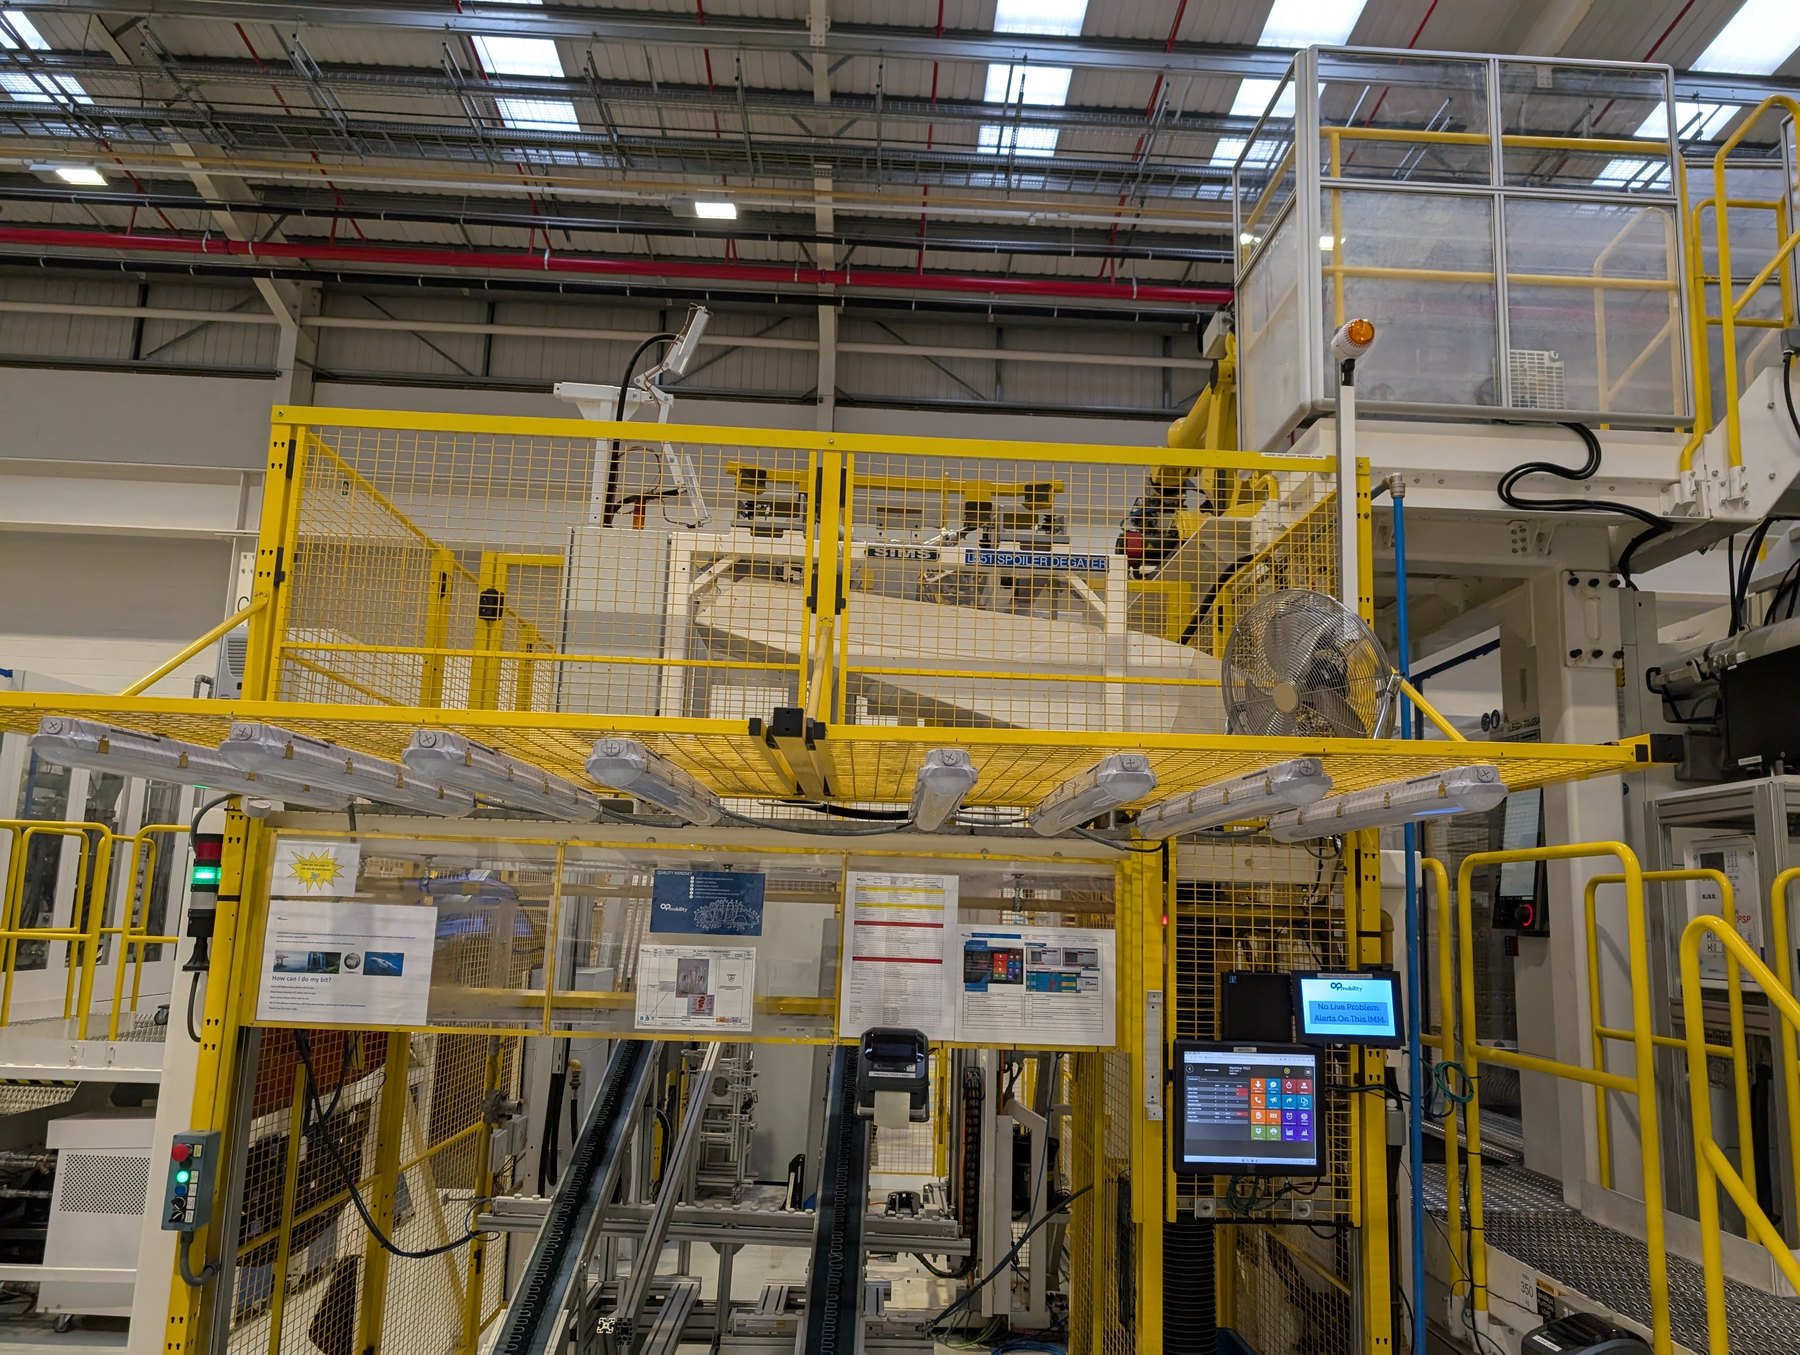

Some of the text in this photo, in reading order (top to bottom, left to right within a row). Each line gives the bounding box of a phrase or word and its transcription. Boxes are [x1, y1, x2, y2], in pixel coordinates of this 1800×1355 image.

[874, 547, 931, 559] SIMS
[997, 554, 1048, 567] SPOILER
[1051, 557, 1108, 569] DEGATER
[1314, 1014, 1337, 1022] Alerts
[1350, 1015, 1367, 1023] This
[1520, 1281, 1534, 1298] 350
